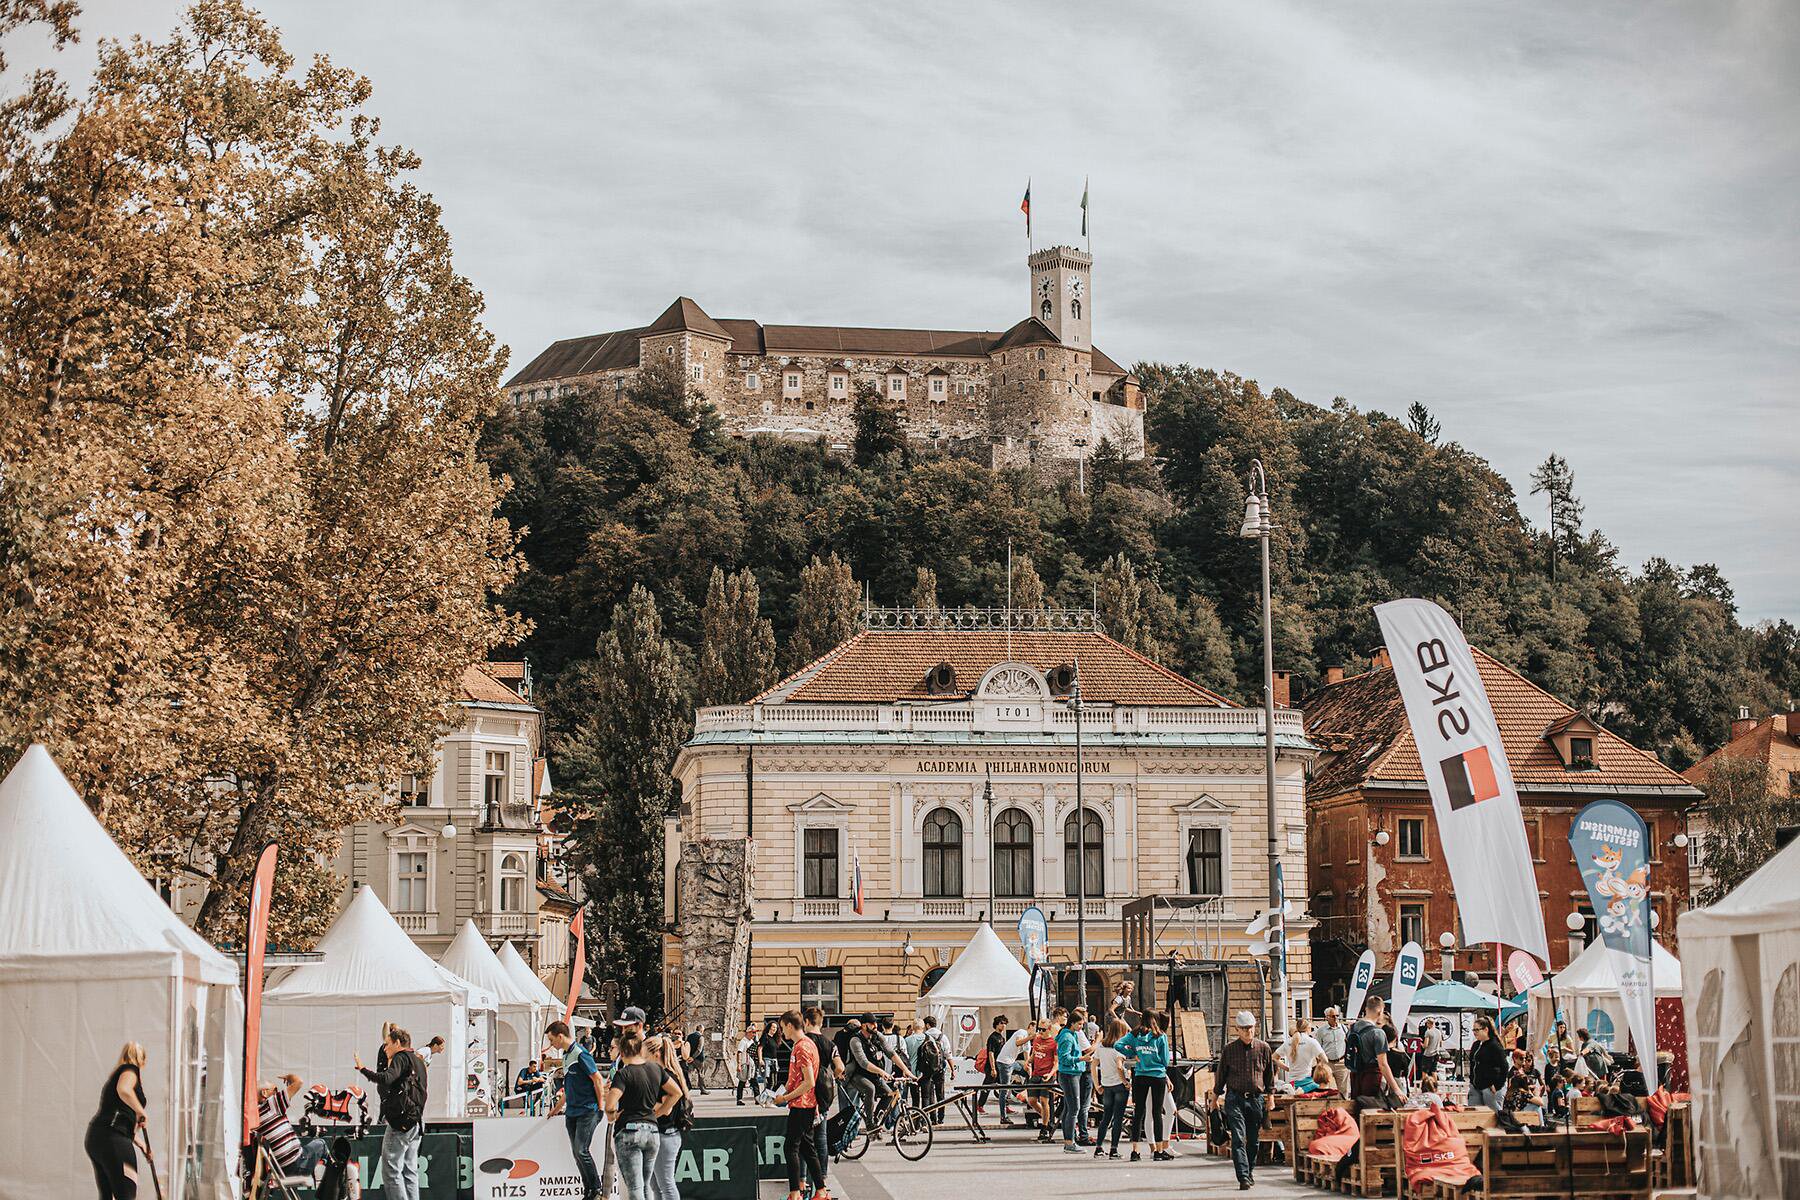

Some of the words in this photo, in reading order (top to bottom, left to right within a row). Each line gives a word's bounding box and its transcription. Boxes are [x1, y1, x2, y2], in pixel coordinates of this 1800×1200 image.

[996, 707, 1031, 717] 1701
[916, 762, 977, 773] ACADEMIA
[1410, 1040, 1418, 1051] 4
[1434, 1151, 1455, 1162] SKB
[674, 1148, 731, 1183] AR
[491, 1182, 527, 1198] ntzs
[540, 1188, 575, 1197] ZVEZA
